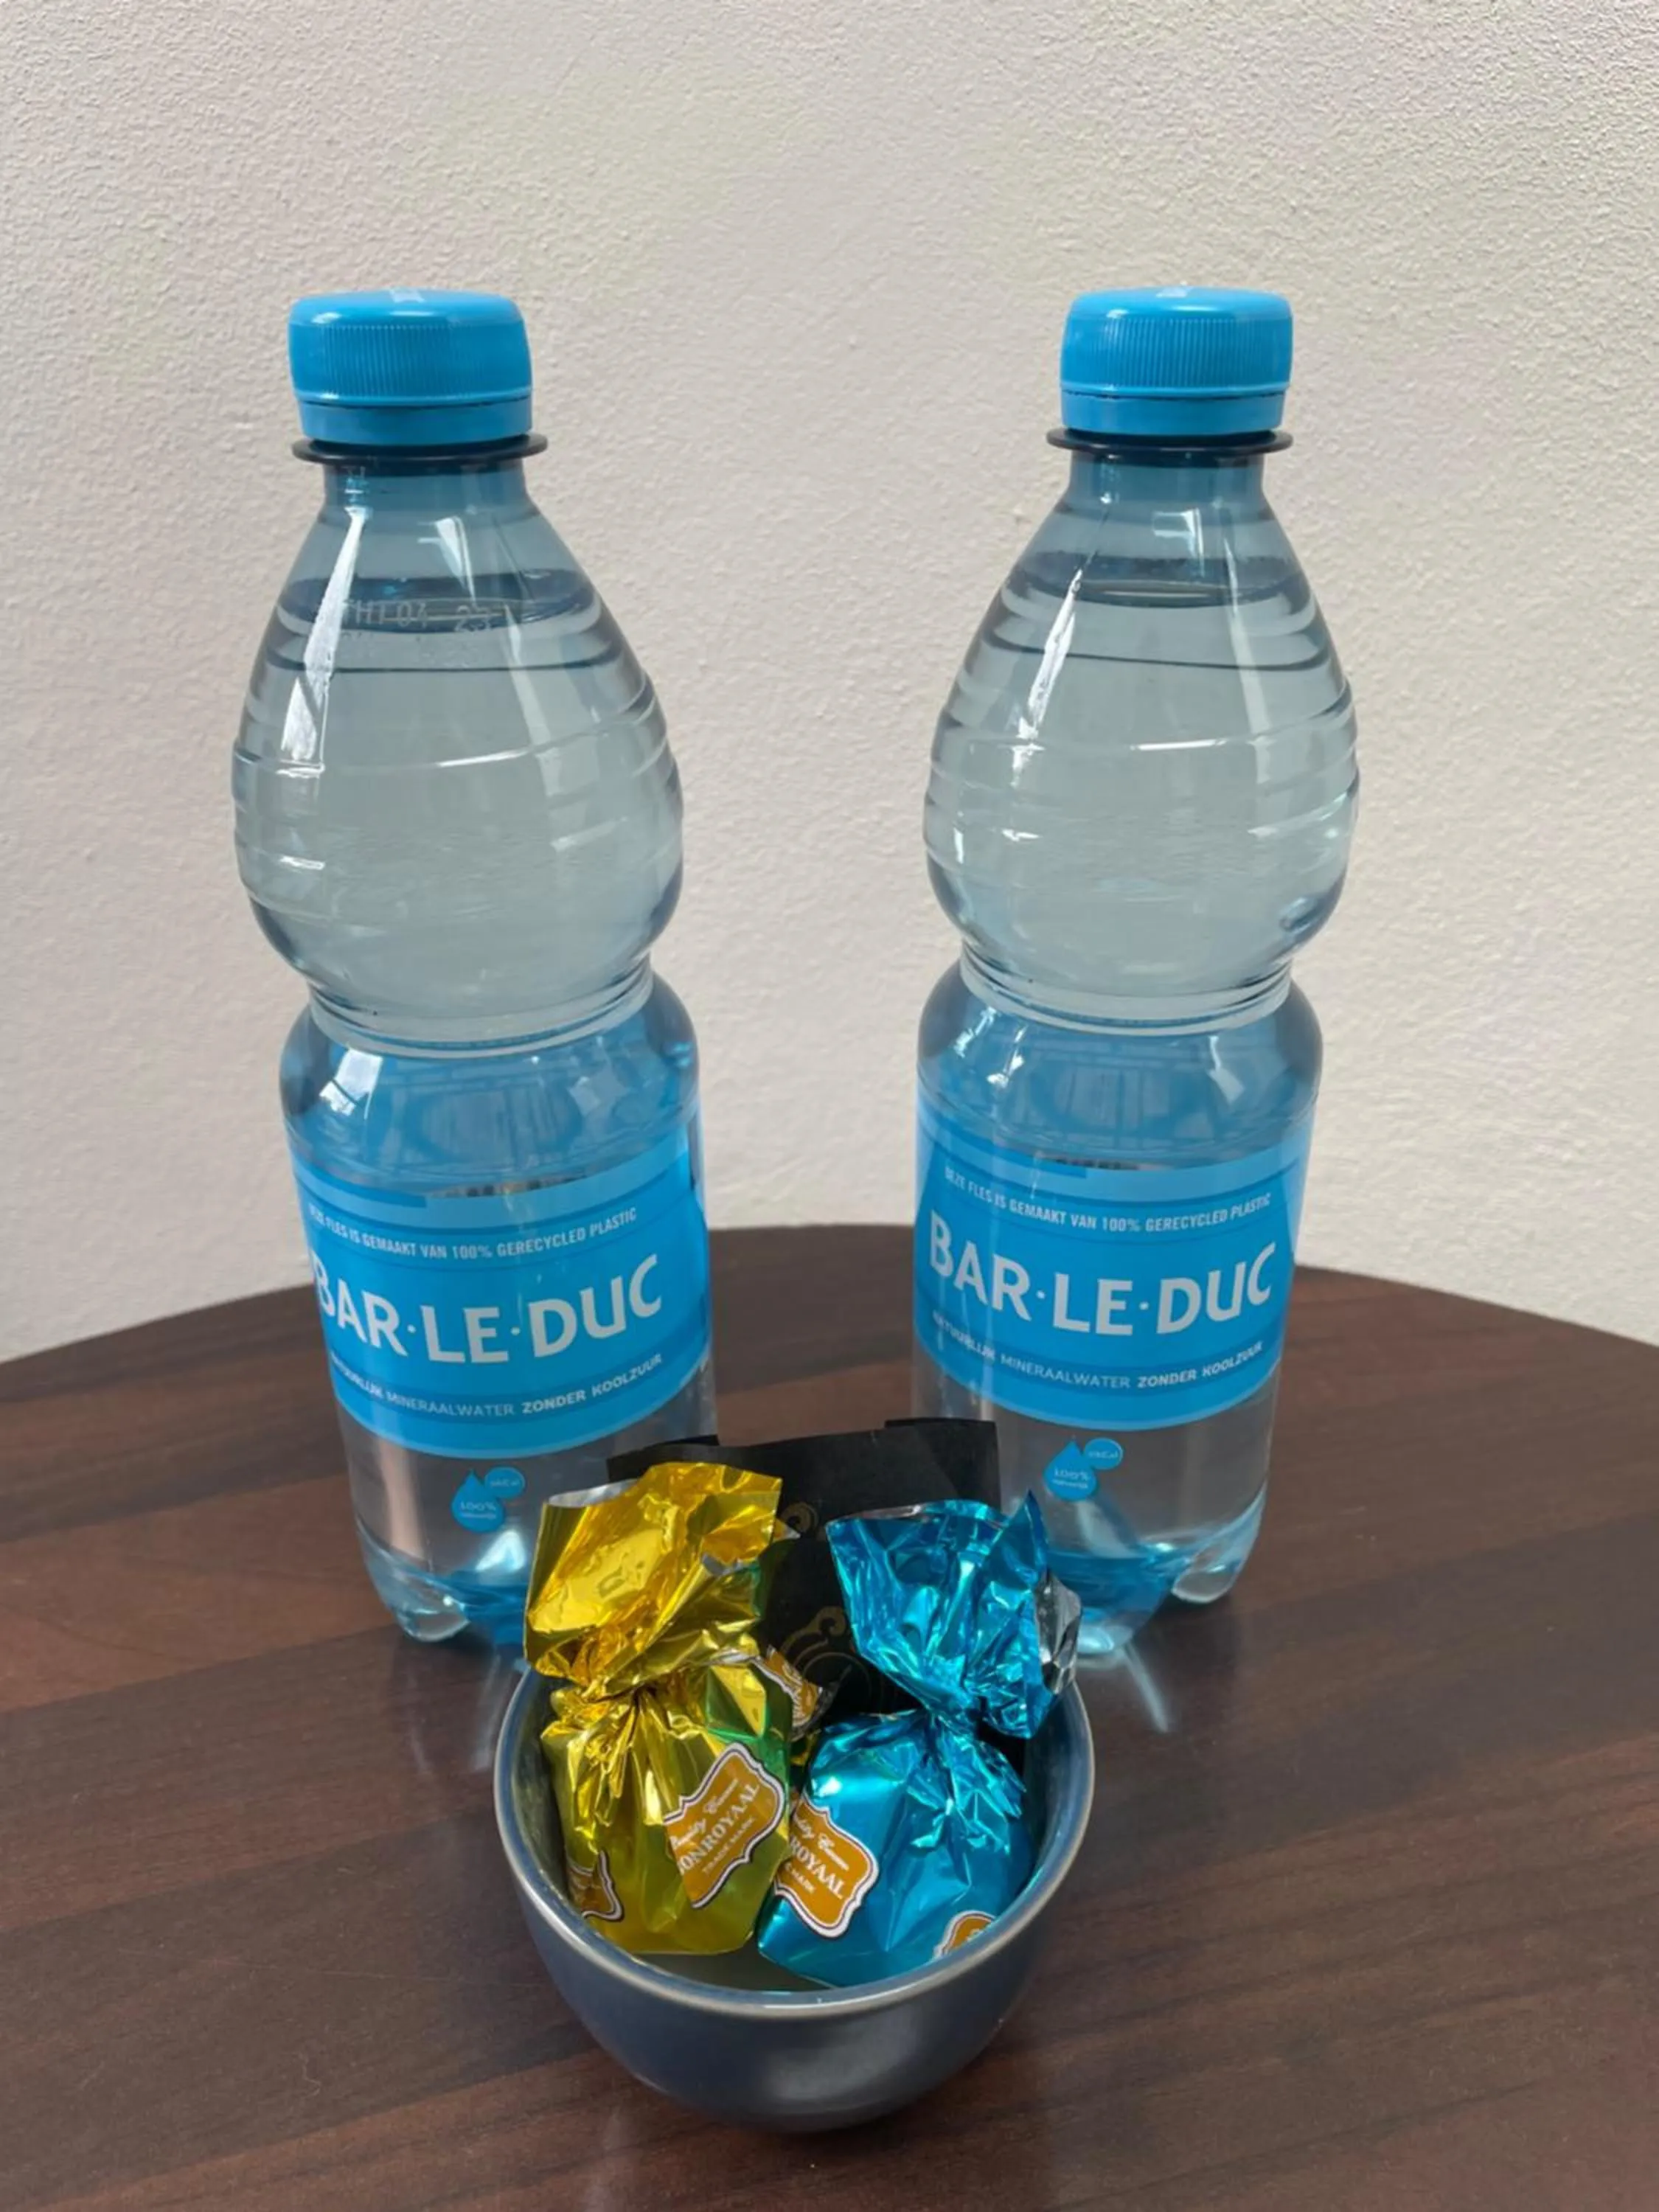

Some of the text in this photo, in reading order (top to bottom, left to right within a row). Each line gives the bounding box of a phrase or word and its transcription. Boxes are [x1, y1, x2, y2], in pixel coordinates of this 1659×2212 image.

[349, 1229, 361, 1244] IS
[361, 1232, 417, 1257] GEMAAKT
[420, 1242, 447, 1259] VAN
[453, 1245, 493, 1260] 100%
[496, 1226, 586, 1257] GERECYCLED
[590, 1206, 637, 1237] PLASTIC
[968, 1180, 992, 1203] FLES
[995, 1195, 1006, 1208] IS
[1009, 1199, 1067, 1225] GEMAAKT
[1070, 1214, 1096, 1230] VAN
[1102, 1217, 1141, 1232] 100%
[1145, 1208, 1228, 1232] GERECYCLED
[1230, 1192, 1272, 1220] PLASTIC
[386, 1391, 515, 1417] MINERAALWATER
[521, 1388, 587, 1414] ZONDER
[591, 1353, 663, 1397] KOOLZUUR
[1000, 1353, 1131, 1389] MINERAALWATER
[1137, 1368, 1197, 1389] ZONDER
[789, 1833, 845, 1900] ROYAAL
